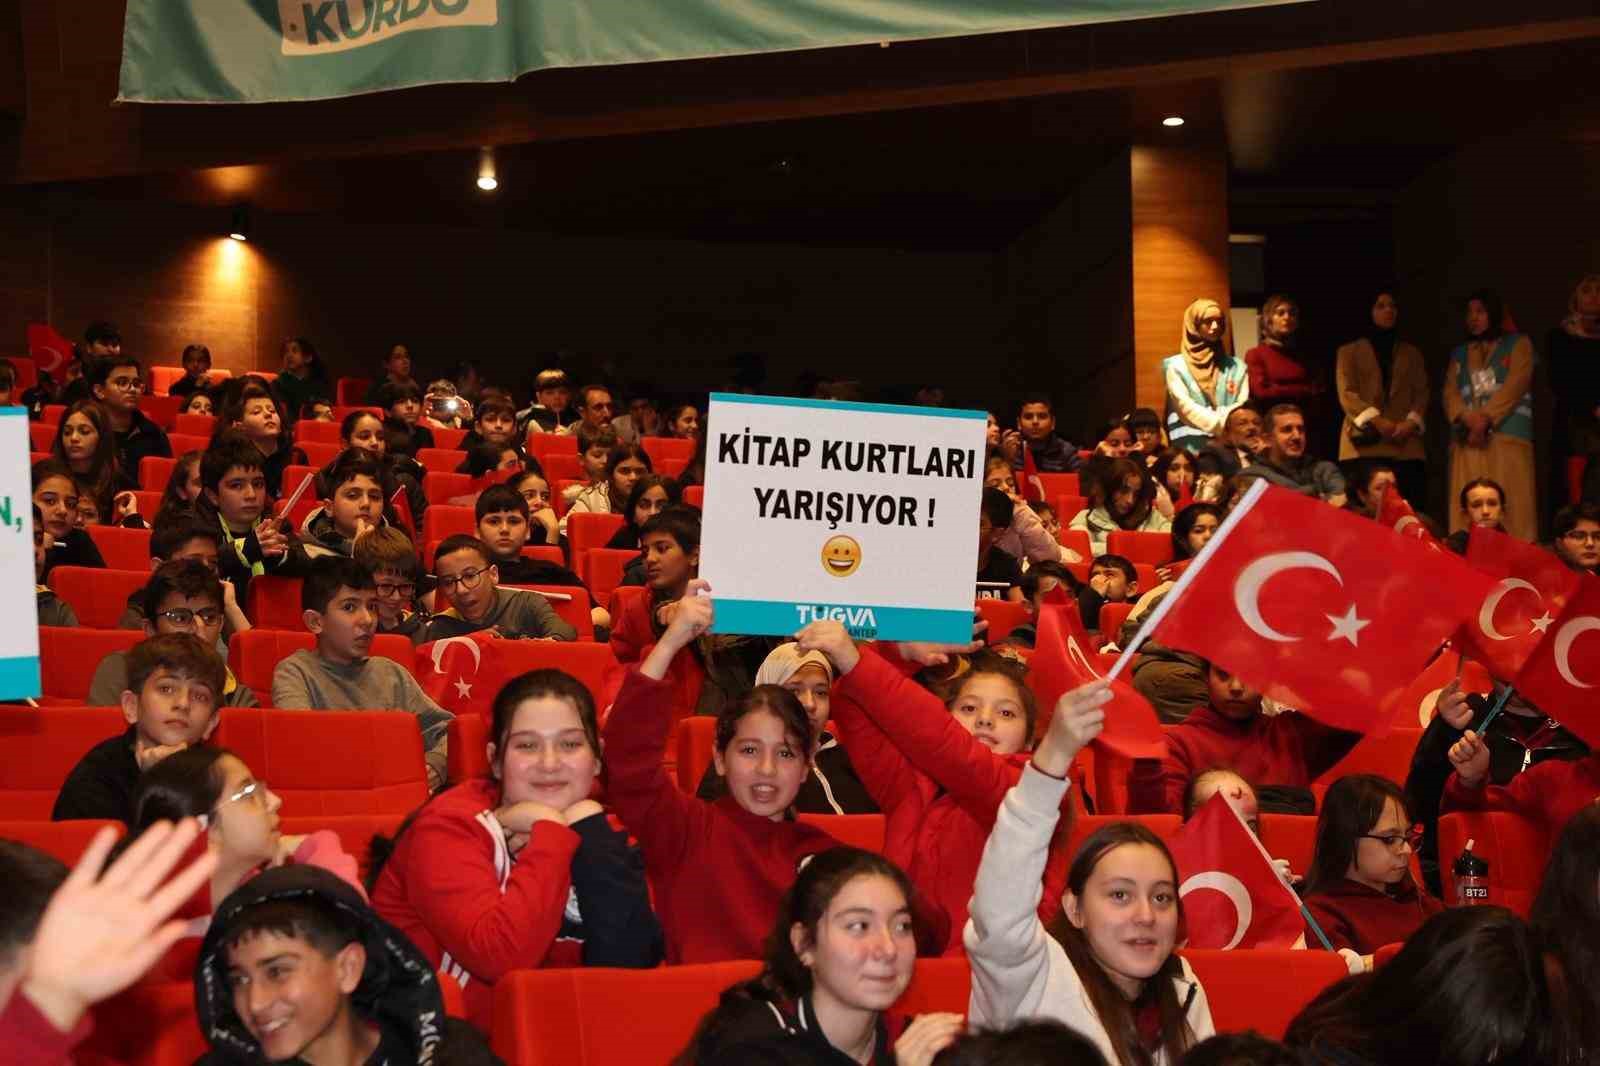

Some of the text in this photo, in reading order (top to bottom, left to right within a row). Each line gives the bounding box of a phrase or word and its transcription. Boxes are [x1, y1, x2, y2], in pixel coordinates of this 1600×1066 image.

[718, 427, 975, 479] KİTAP KURTLARI
[753, 487, 936, 530] YARIŞIYOR !
